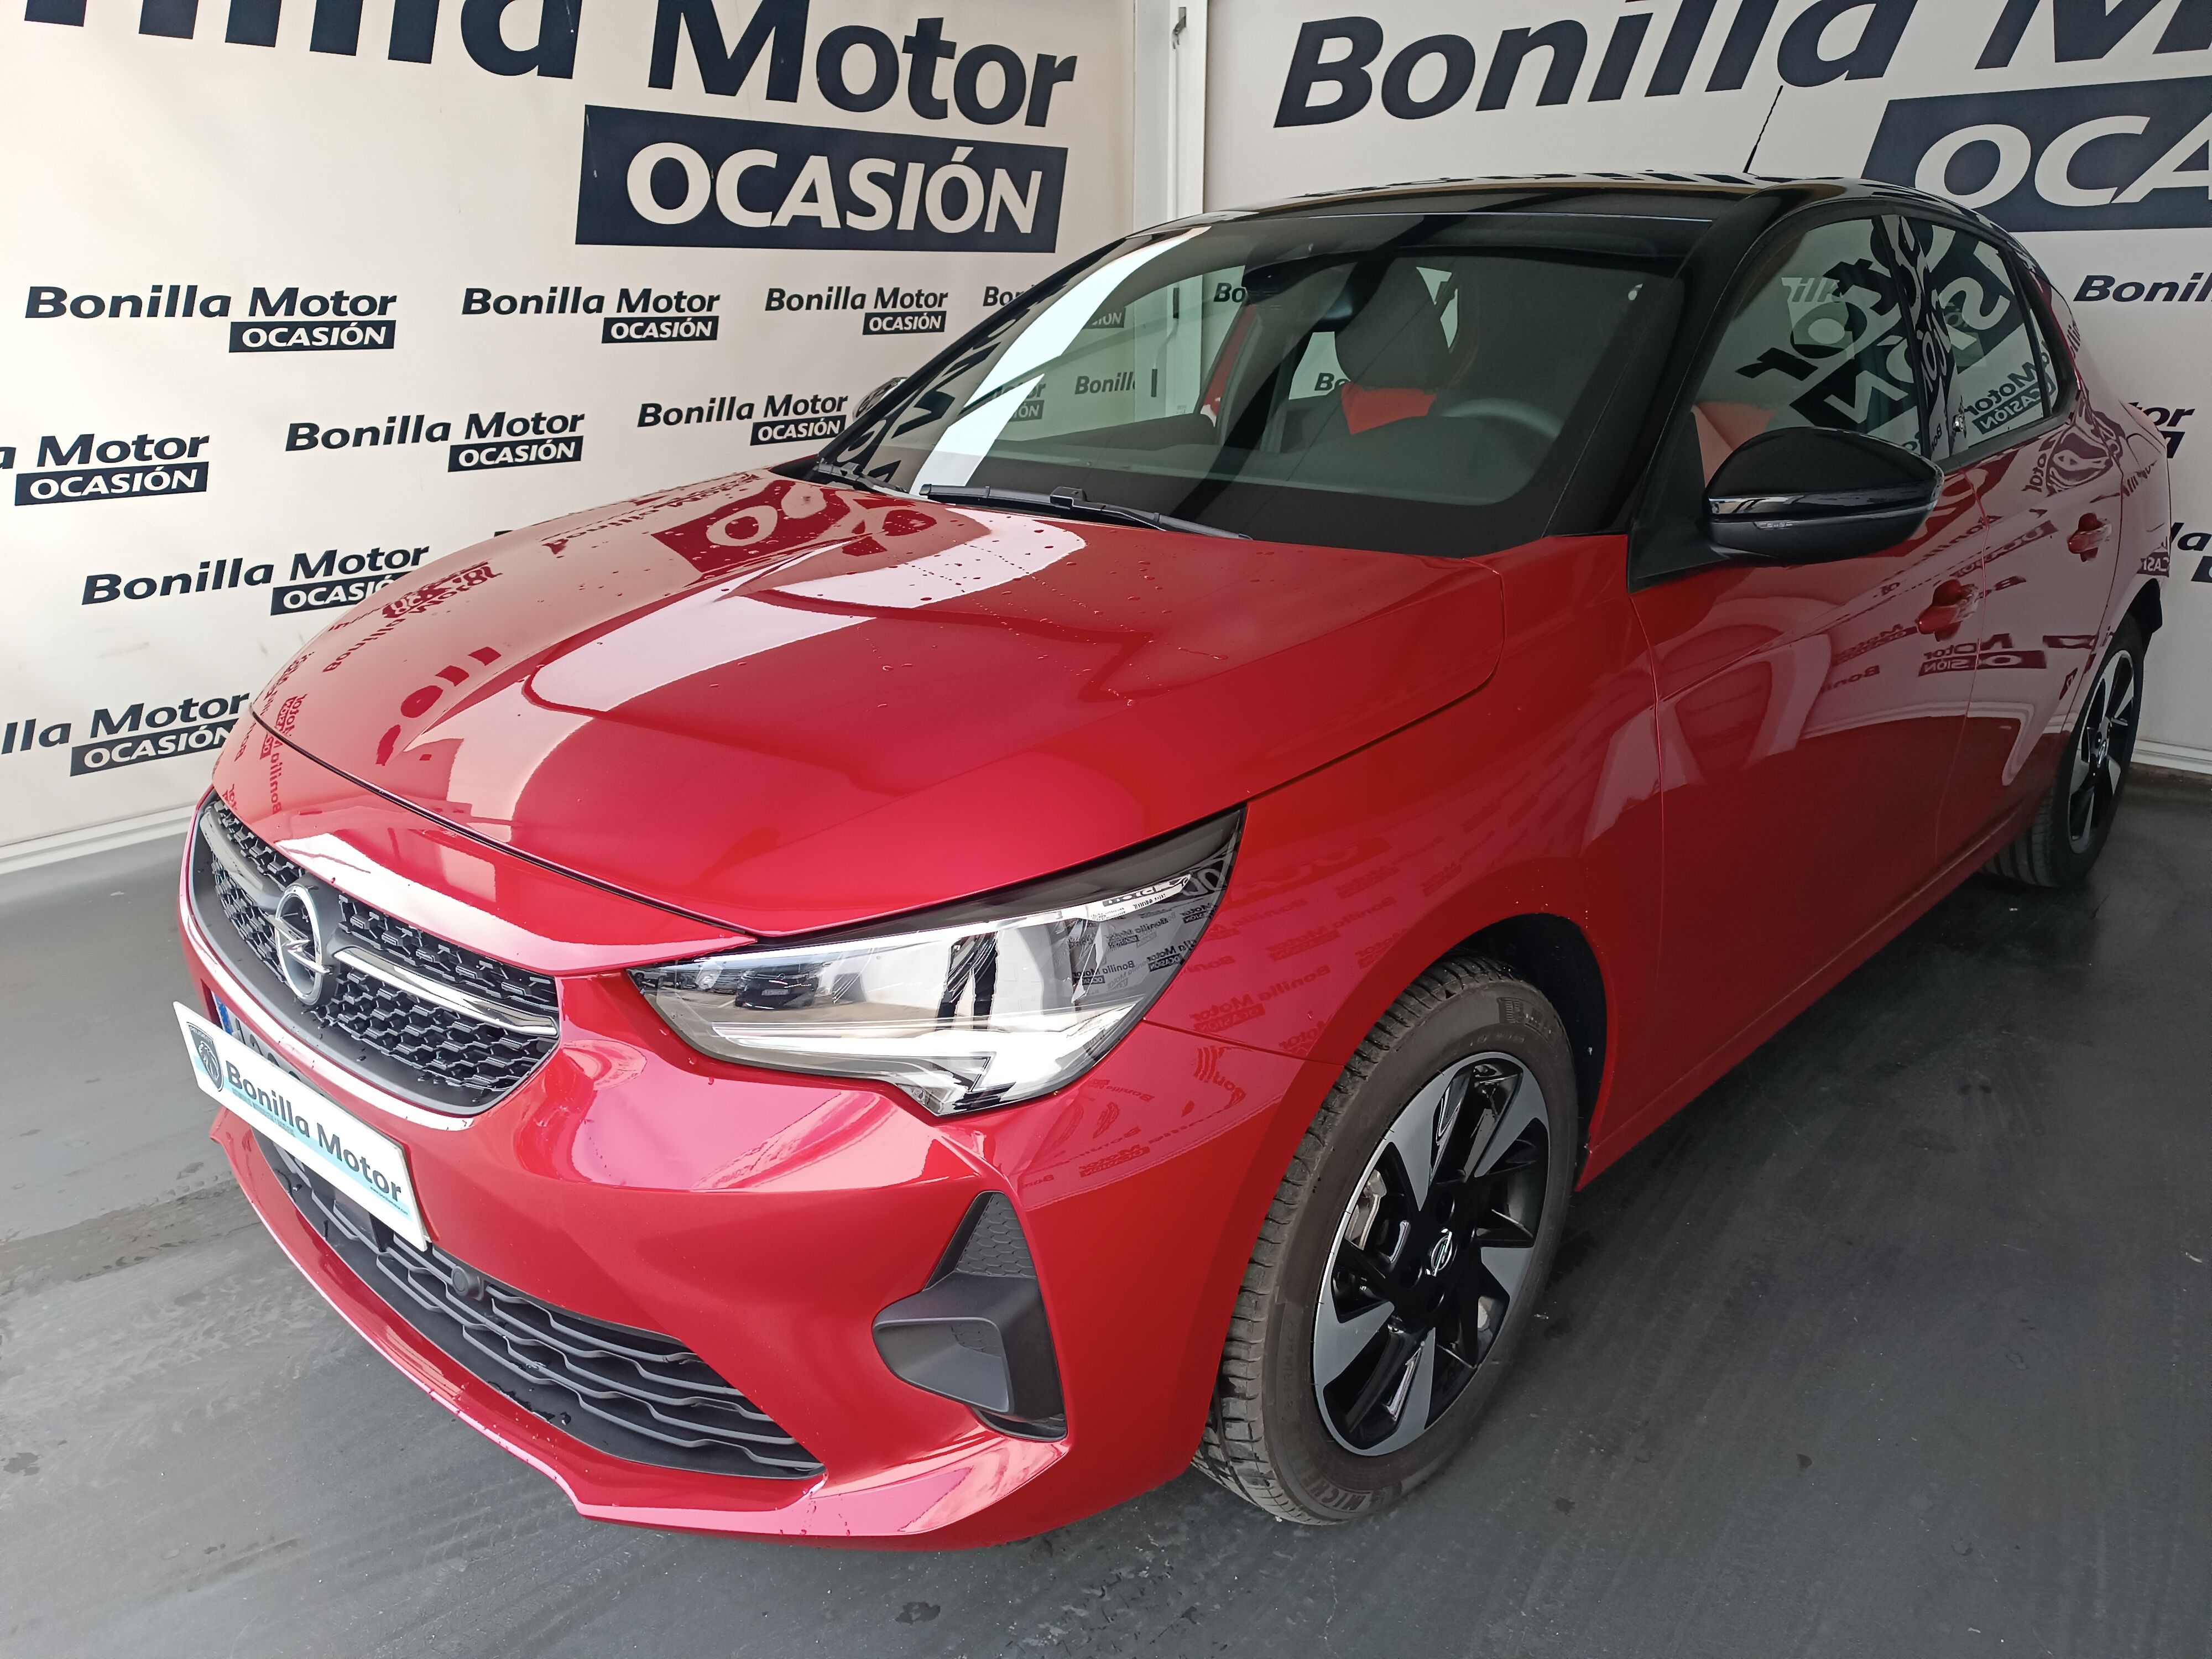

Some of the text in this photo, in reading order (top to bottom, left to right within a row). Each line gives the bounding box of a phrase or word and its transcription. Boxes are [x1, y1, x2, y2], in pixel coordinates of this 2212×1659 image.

[648, 0, 1077, 127] Motor
[1273, 0, 1918, 128] Bonilla
[627, 142, 1042, 234] OCASIÓN
[25, 285, 397, 319] Bonilla Motor
[462, 286, 720, 315] Bonilla Motor
[765, 286, 948, 311] Bonilla Motor
[242, 321, 387, 348] OCASIÓN
[611, 317, 712, 339] OCASIÓN
[869, 311, 942, 332] OCASIÓN
[1074, 372, 1135, 395] Bonill
[638, 393, 848, 427] Bonilla Motor
[285, 411, 585, 451] Bonilla Motor
[757, 418, 841, 442] OCASIÓN
[37, 434, 210, 467] Motor
[458, 436, 575, 467] OCASIÓN
[30, 467, 197, 499] OCASIÓN
[82, 546, 429, 605] Bonilla Motor
[283, 576, 394, 608] OCASIÓ
[90, 692, 250, 738] Motor
[226, 1060, 310, 1138] Bonilla
[317, 1123, 401, 1202] Motor
